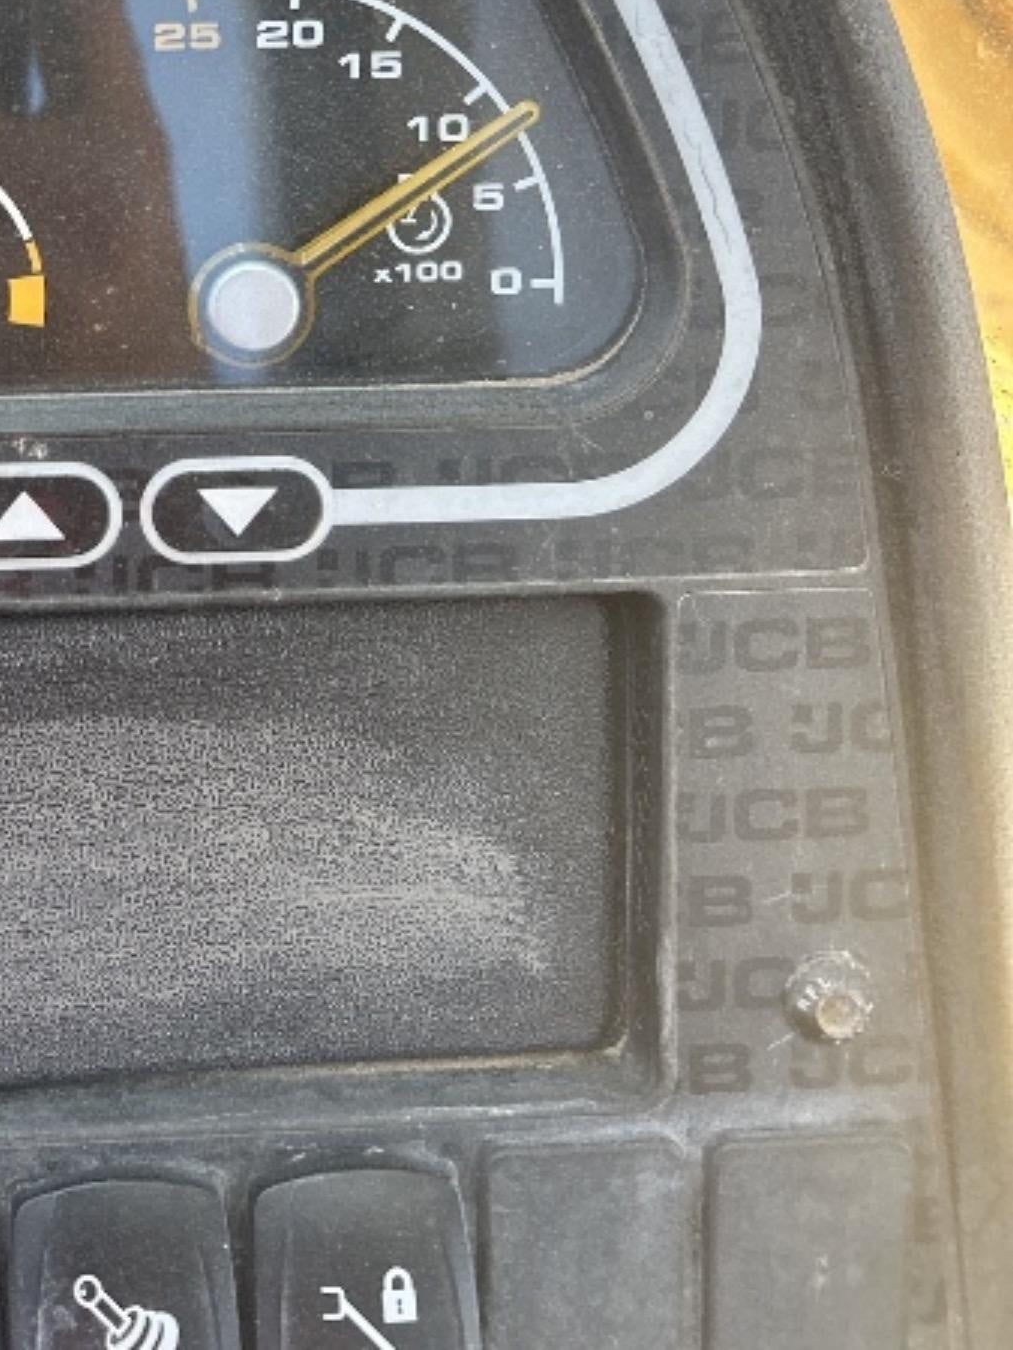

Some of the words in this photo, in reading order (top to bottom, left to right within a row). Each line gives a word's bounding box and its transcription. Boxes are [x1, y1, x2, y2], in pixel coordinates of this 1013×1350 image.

[153, 22, 221, 50] 25
[256, 20, 324, 49] 20
[338, 50, 403, 80] 15
[407, 114, 470, 143] 10
[472, 183, 505, 211] 5
[373, 261, 463, 283] x100
[490, 269, 523, 295] 0
